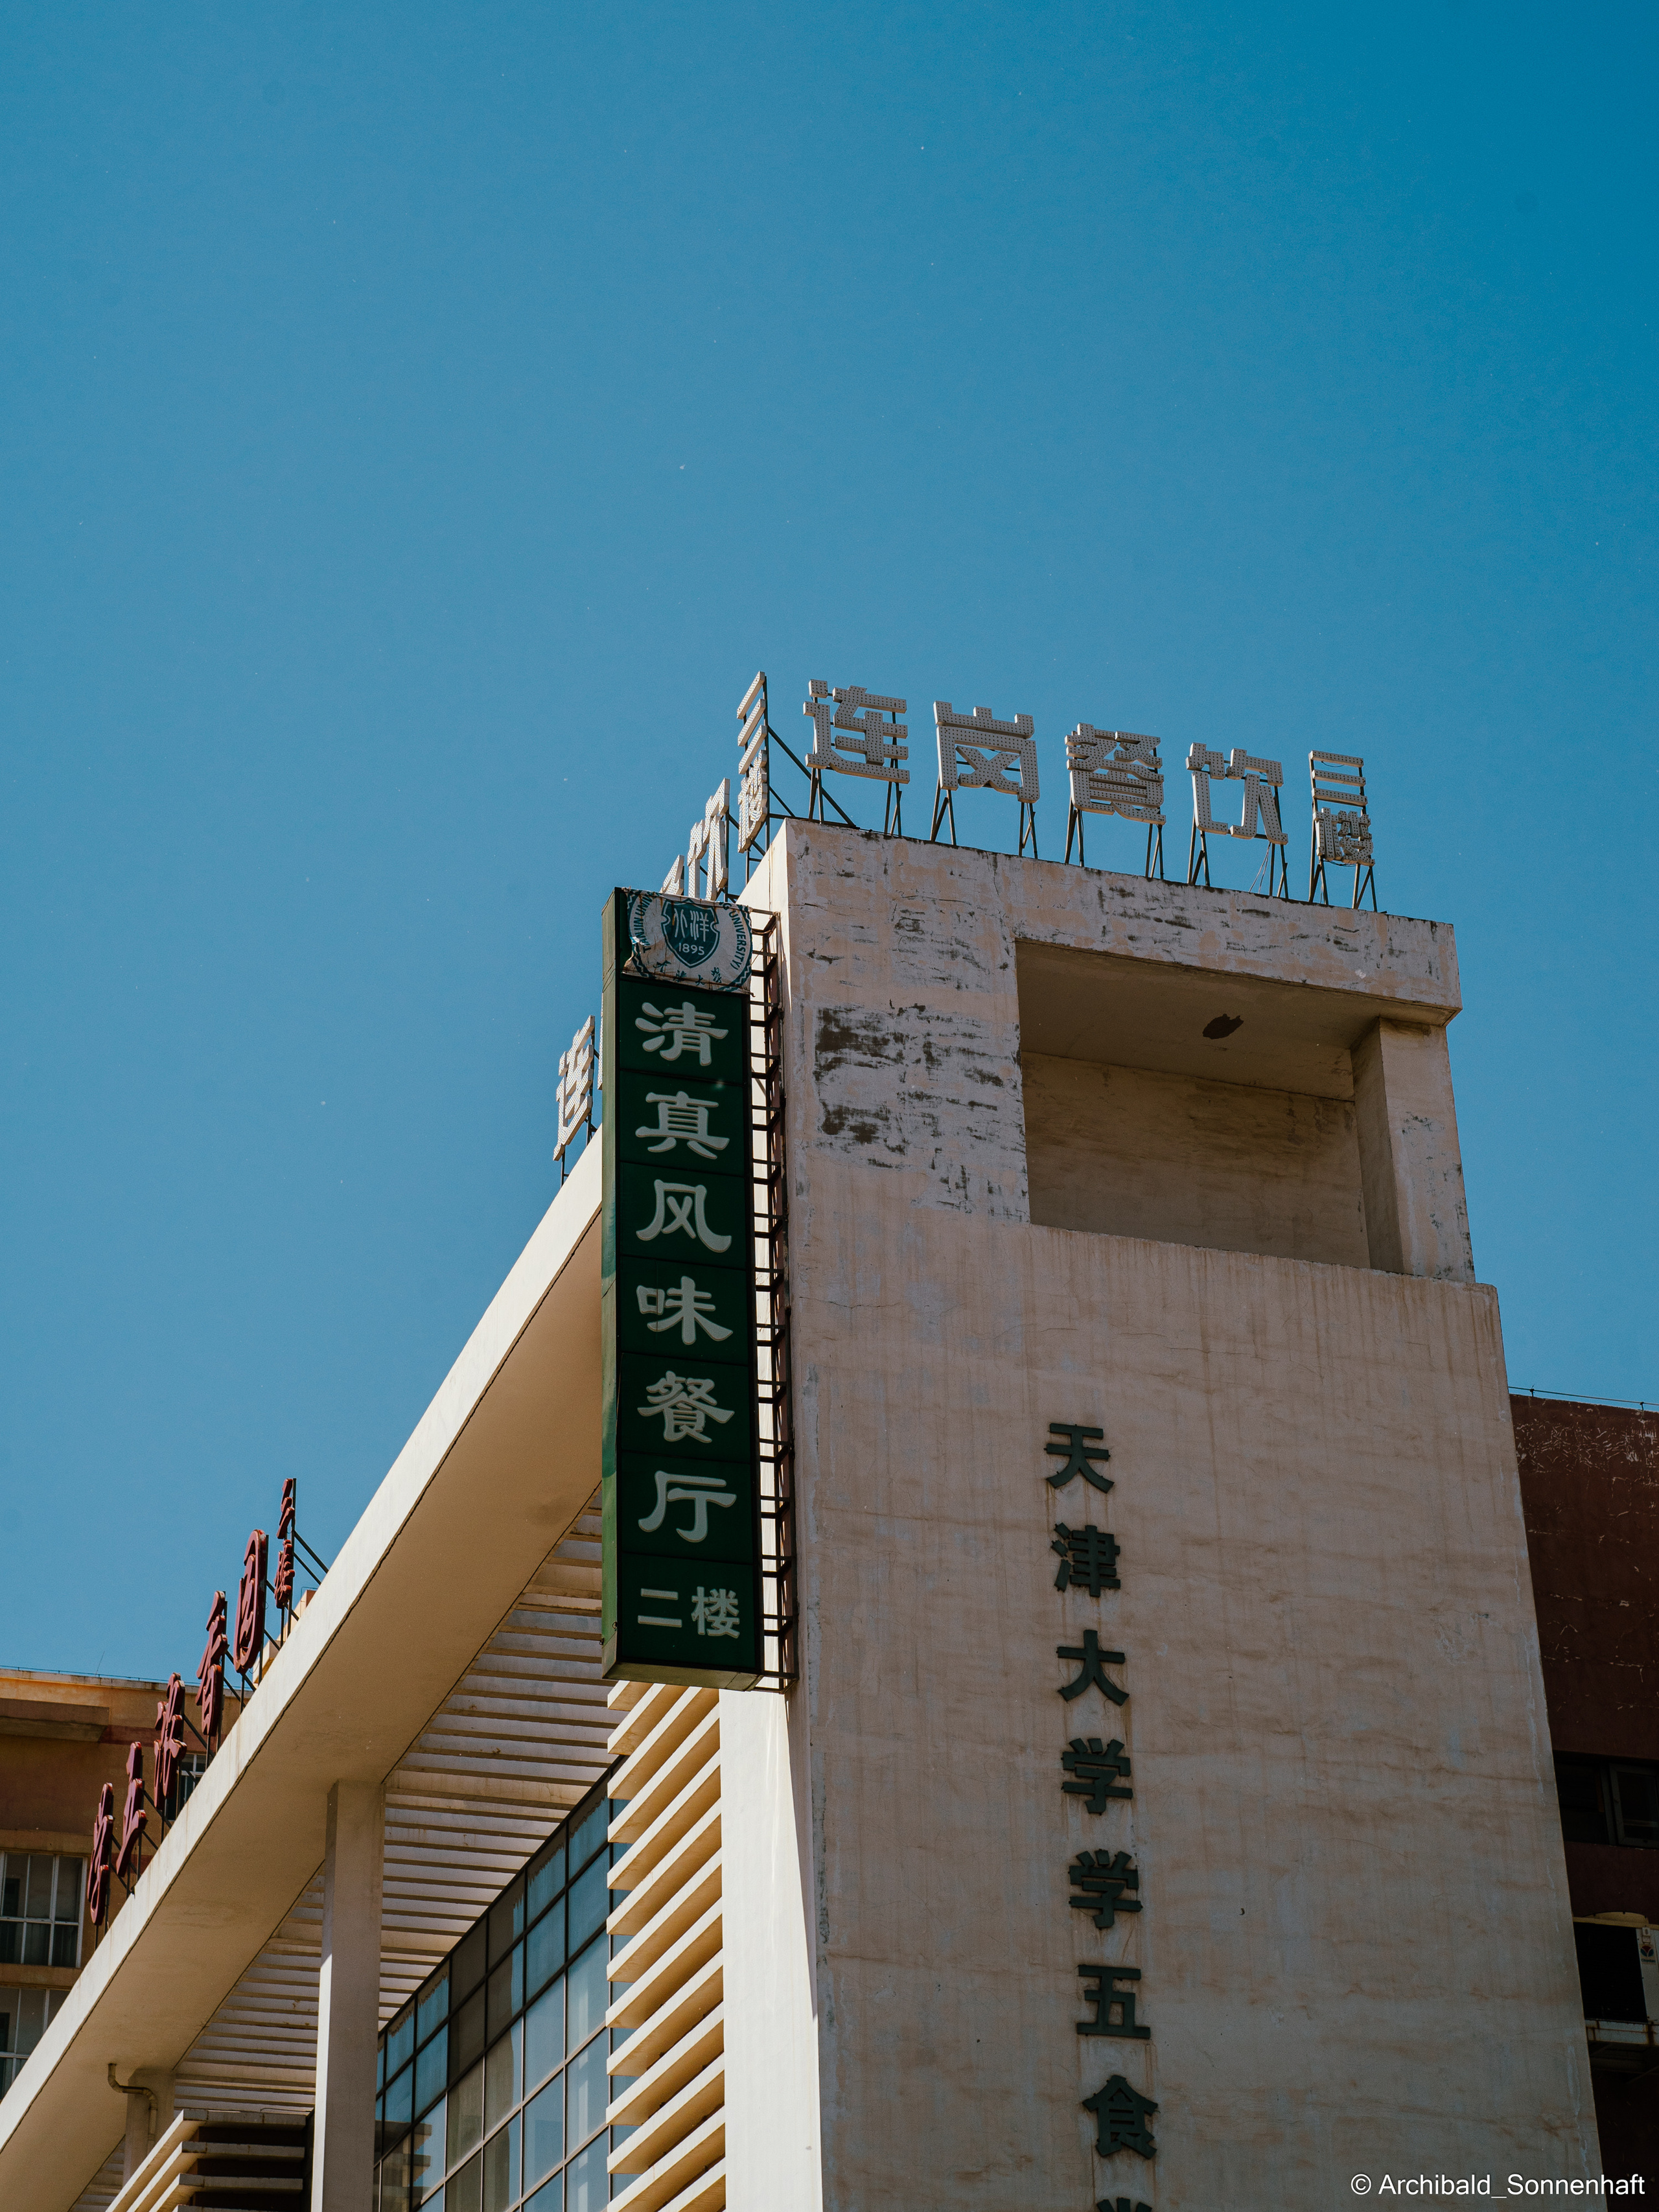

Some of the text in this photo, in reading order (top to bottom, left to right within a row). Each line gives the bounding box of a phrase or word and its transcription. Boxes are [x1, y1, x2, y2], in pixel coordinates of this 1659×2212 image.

[803, 679, 1288, 845] 连岗餐饮
[1310, 750, 1375, 867] 三楼
[679, 942, 705, 956] 1895
[634, 1001, 737, 1543] 清真风味餐厅
[638, 1586, 740, 1638] 二楼
[1045, 1423, 1159, 2212] 天津大学学五食
